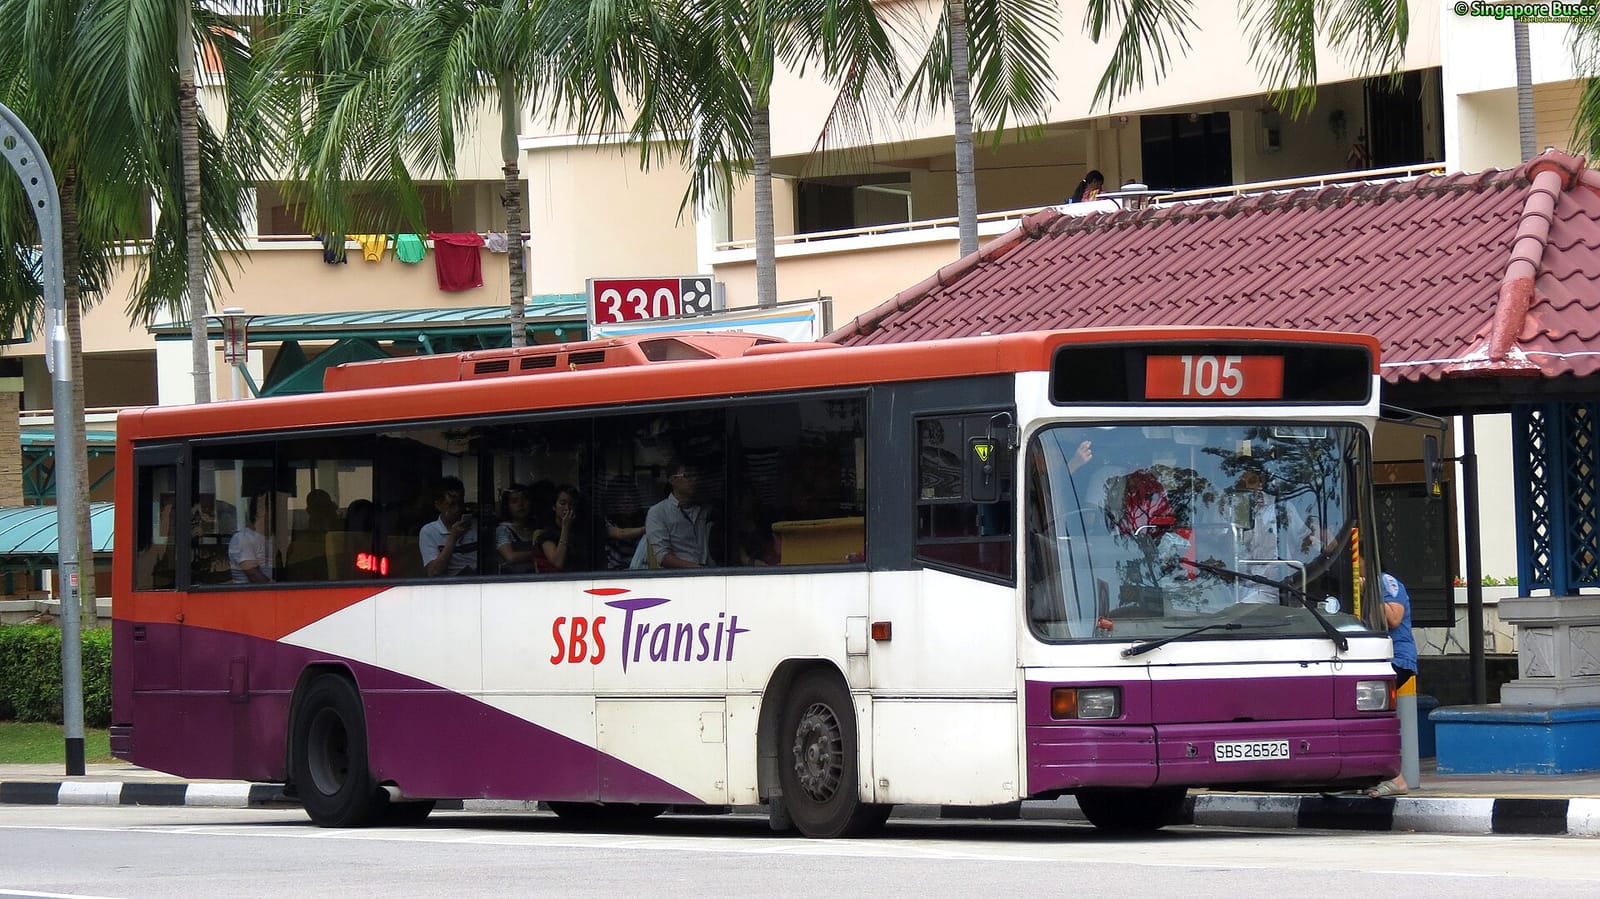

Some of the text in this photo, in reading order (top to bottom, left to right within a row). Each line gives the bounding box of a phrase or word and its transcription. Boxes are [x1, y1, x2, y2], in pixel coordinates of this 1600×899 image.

[1180, 355, 1243, 397] 105
[550, 597, 751, 675] SBS Transit
[1216, 743, 1288, 758] SBS2652G
